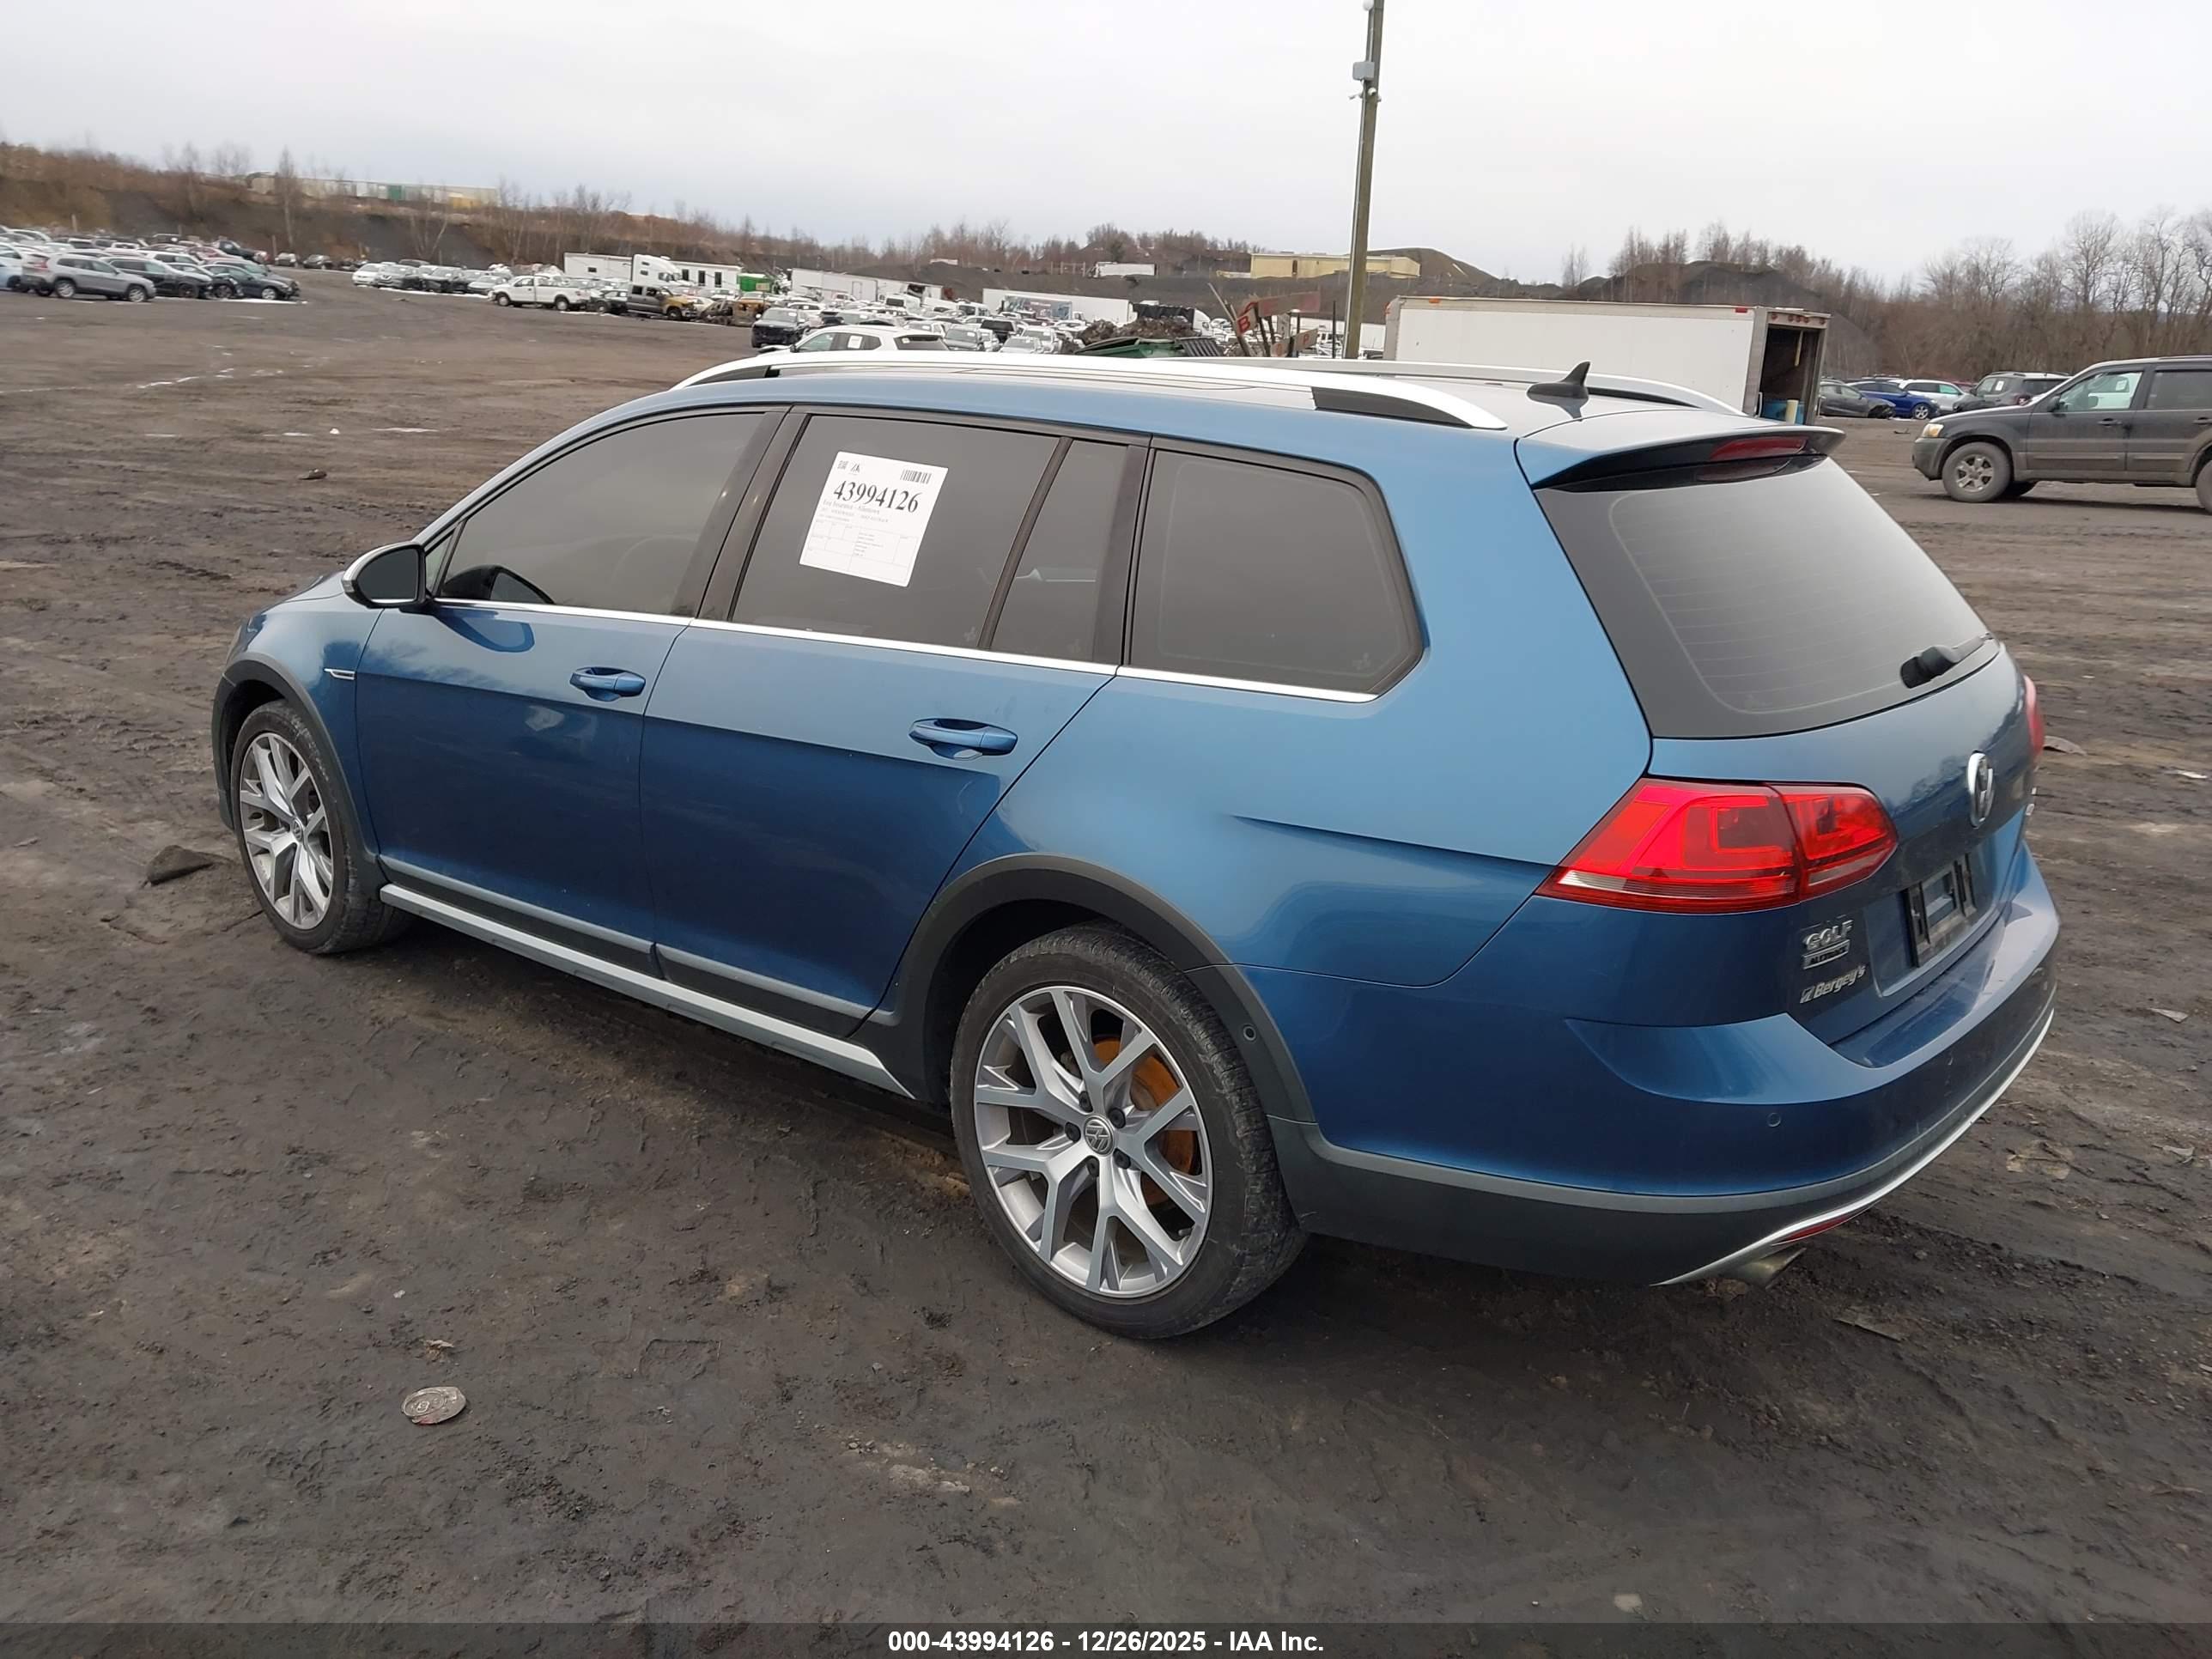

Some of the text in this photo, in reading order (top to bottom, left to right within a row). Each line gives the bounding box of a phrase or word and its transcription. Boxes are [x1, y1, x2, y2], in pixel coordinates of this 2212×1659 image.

[833, 480, 923, 514] 43994126
[1805, 920, 1853, 951] GOLF
[1814, 965, 1866, 1000] Bergey's
